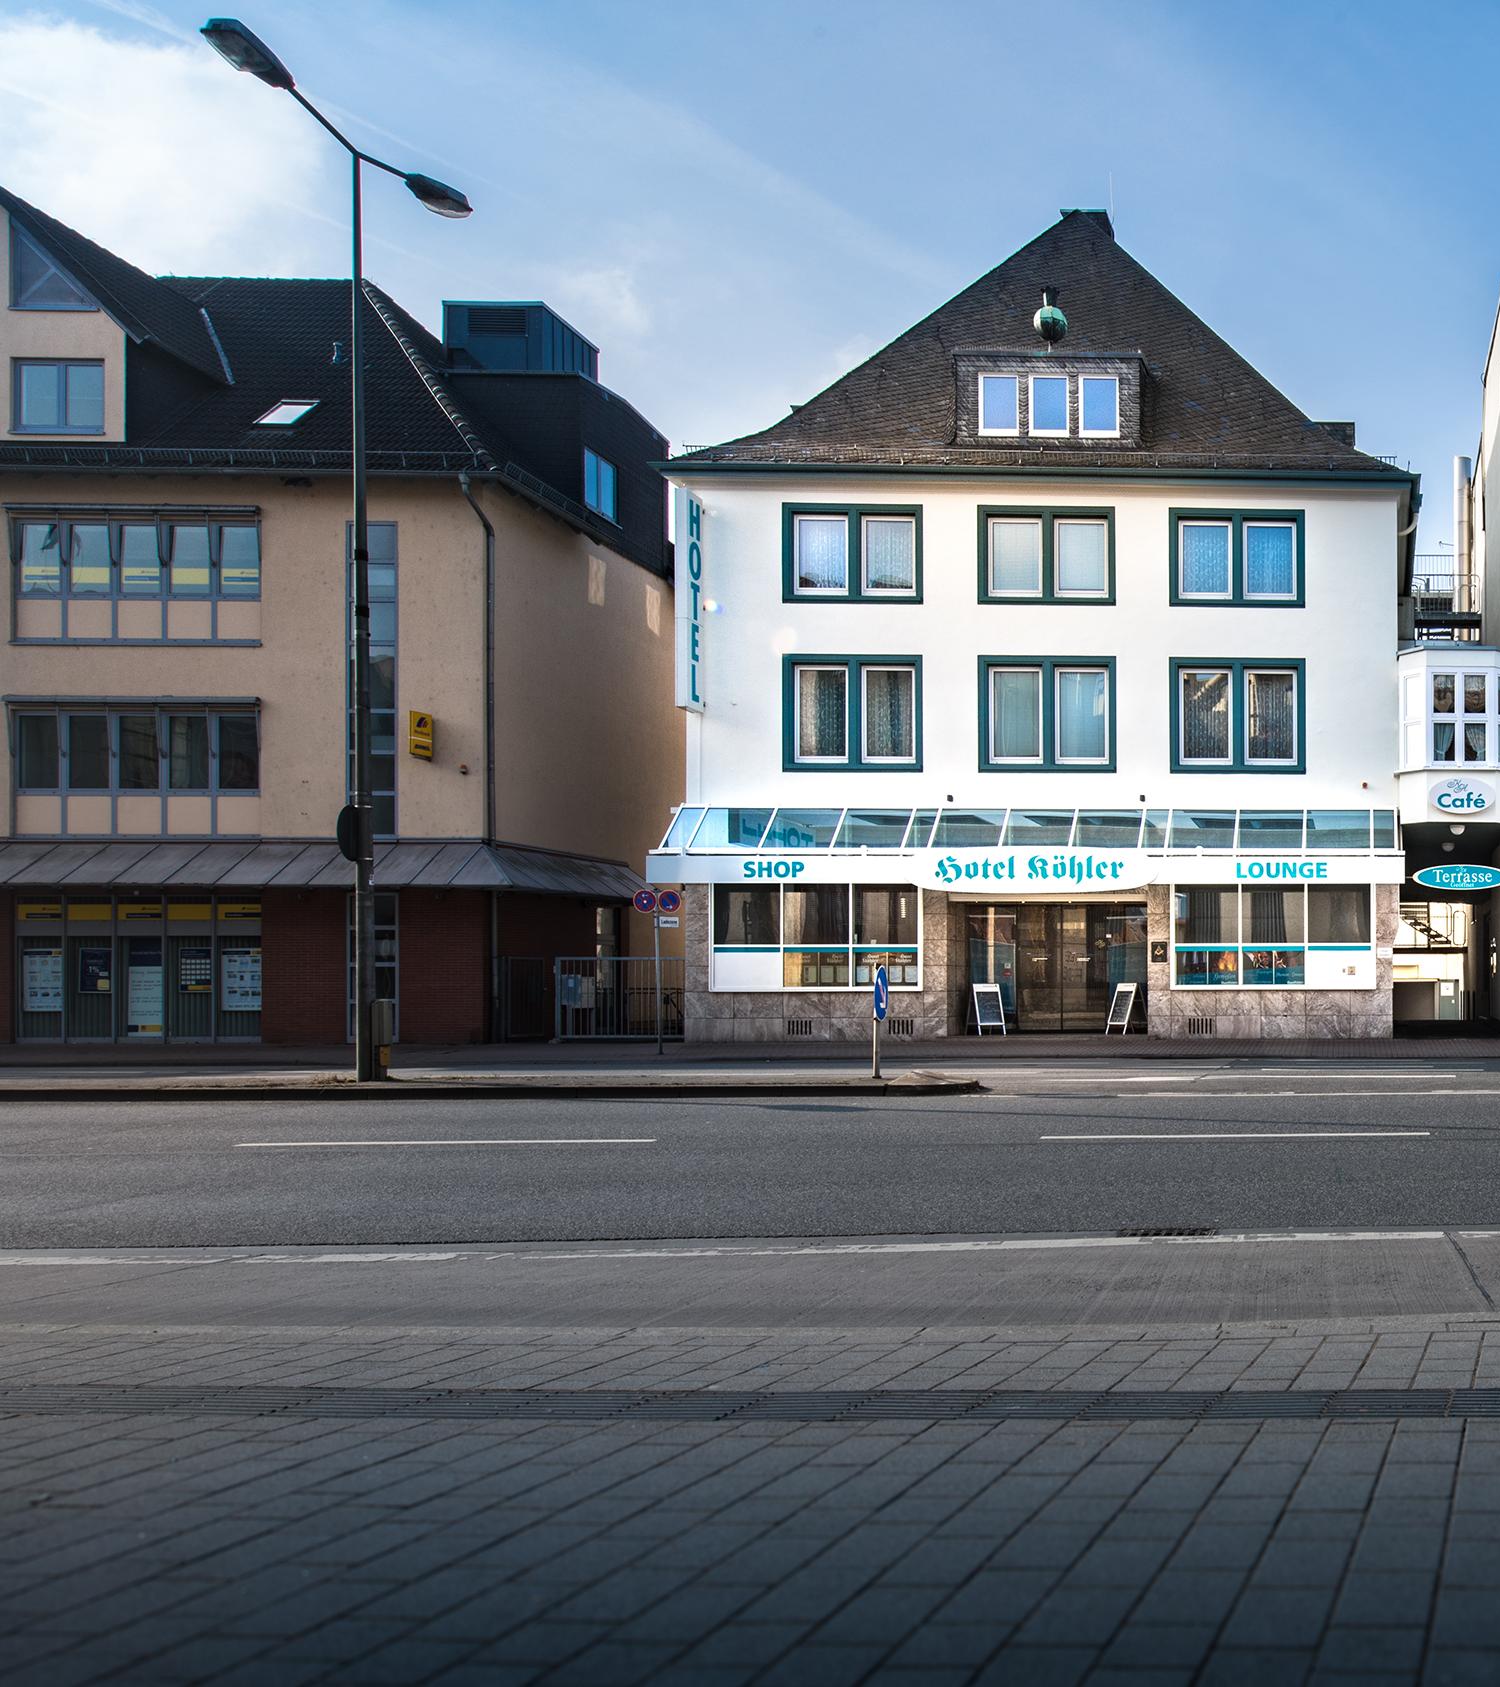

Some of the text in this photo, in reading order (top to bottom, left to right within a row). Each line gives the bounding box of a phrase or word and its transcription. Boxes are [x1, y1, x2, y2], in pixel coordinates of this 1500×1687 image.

[688, 499, 702, 703] HOTEL
[1437, 792, 1486, 809] Café
[743, 861, 805, 879] SHOP
[934, 855, 1124, 885] Hotel Köhler
[1236, 862, 1328, 879] LOUNGE
[1432, 869, 1493, 884] Terrasse
